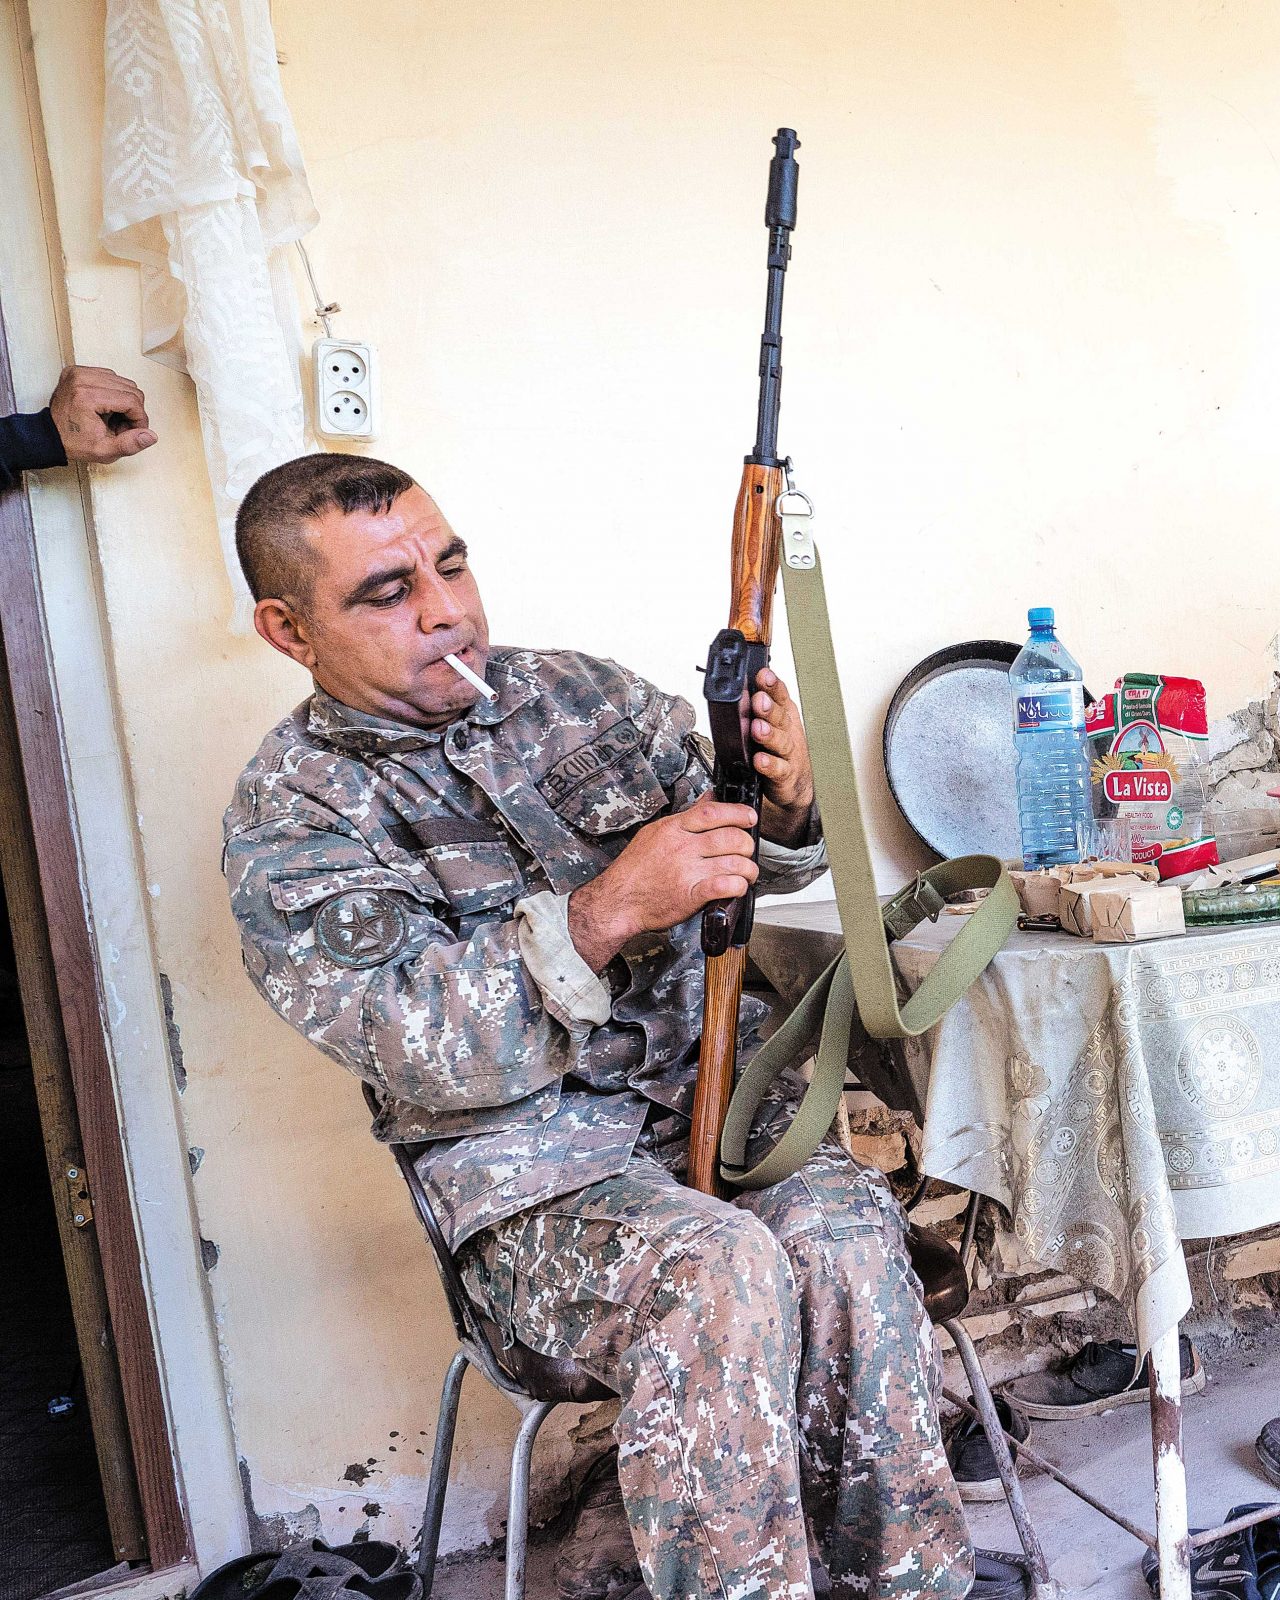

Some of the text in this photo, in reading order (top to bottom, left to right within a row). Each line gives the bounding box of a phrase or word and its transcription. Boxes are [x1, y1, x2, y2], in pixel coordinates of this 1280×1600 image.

[1113, 777, 1168, 796] La Vista
[1131, 849, 1155, 860] RODUCT
